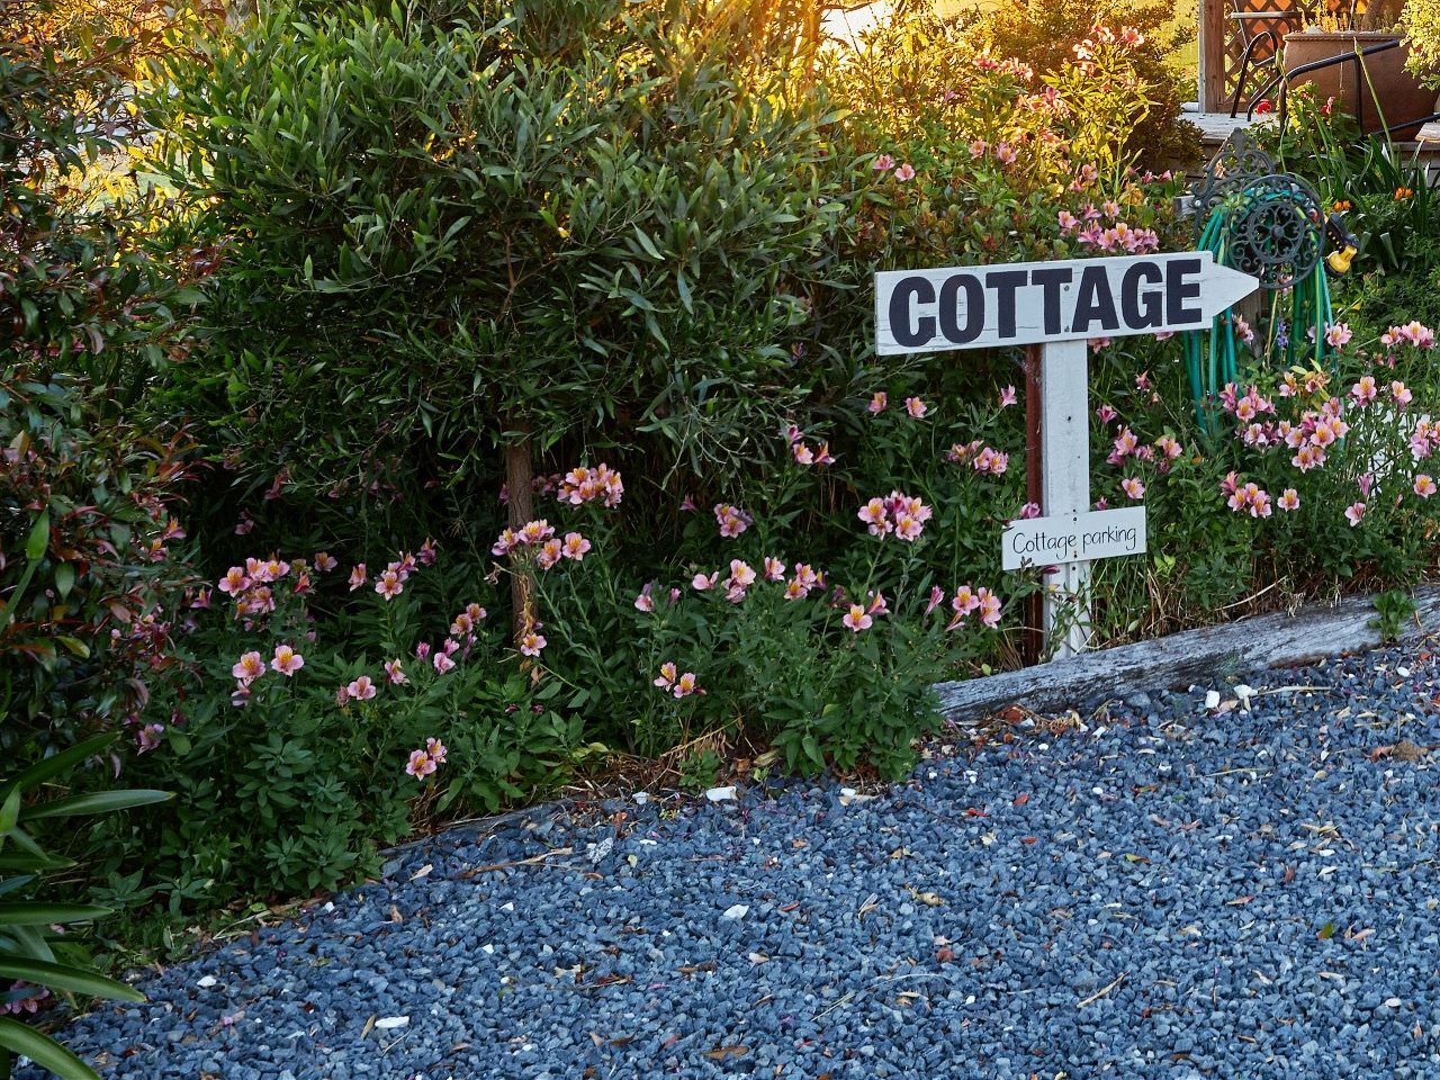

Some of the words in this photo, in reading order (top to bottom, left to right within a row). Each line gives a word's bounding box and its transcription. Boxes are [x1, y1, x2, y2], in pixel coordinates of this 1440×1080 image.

[889, 259, 1202, 347] COTTAGE
[1013, 532, 1077, 560] Cottage
[1083, 525, 1137, 554] parking
